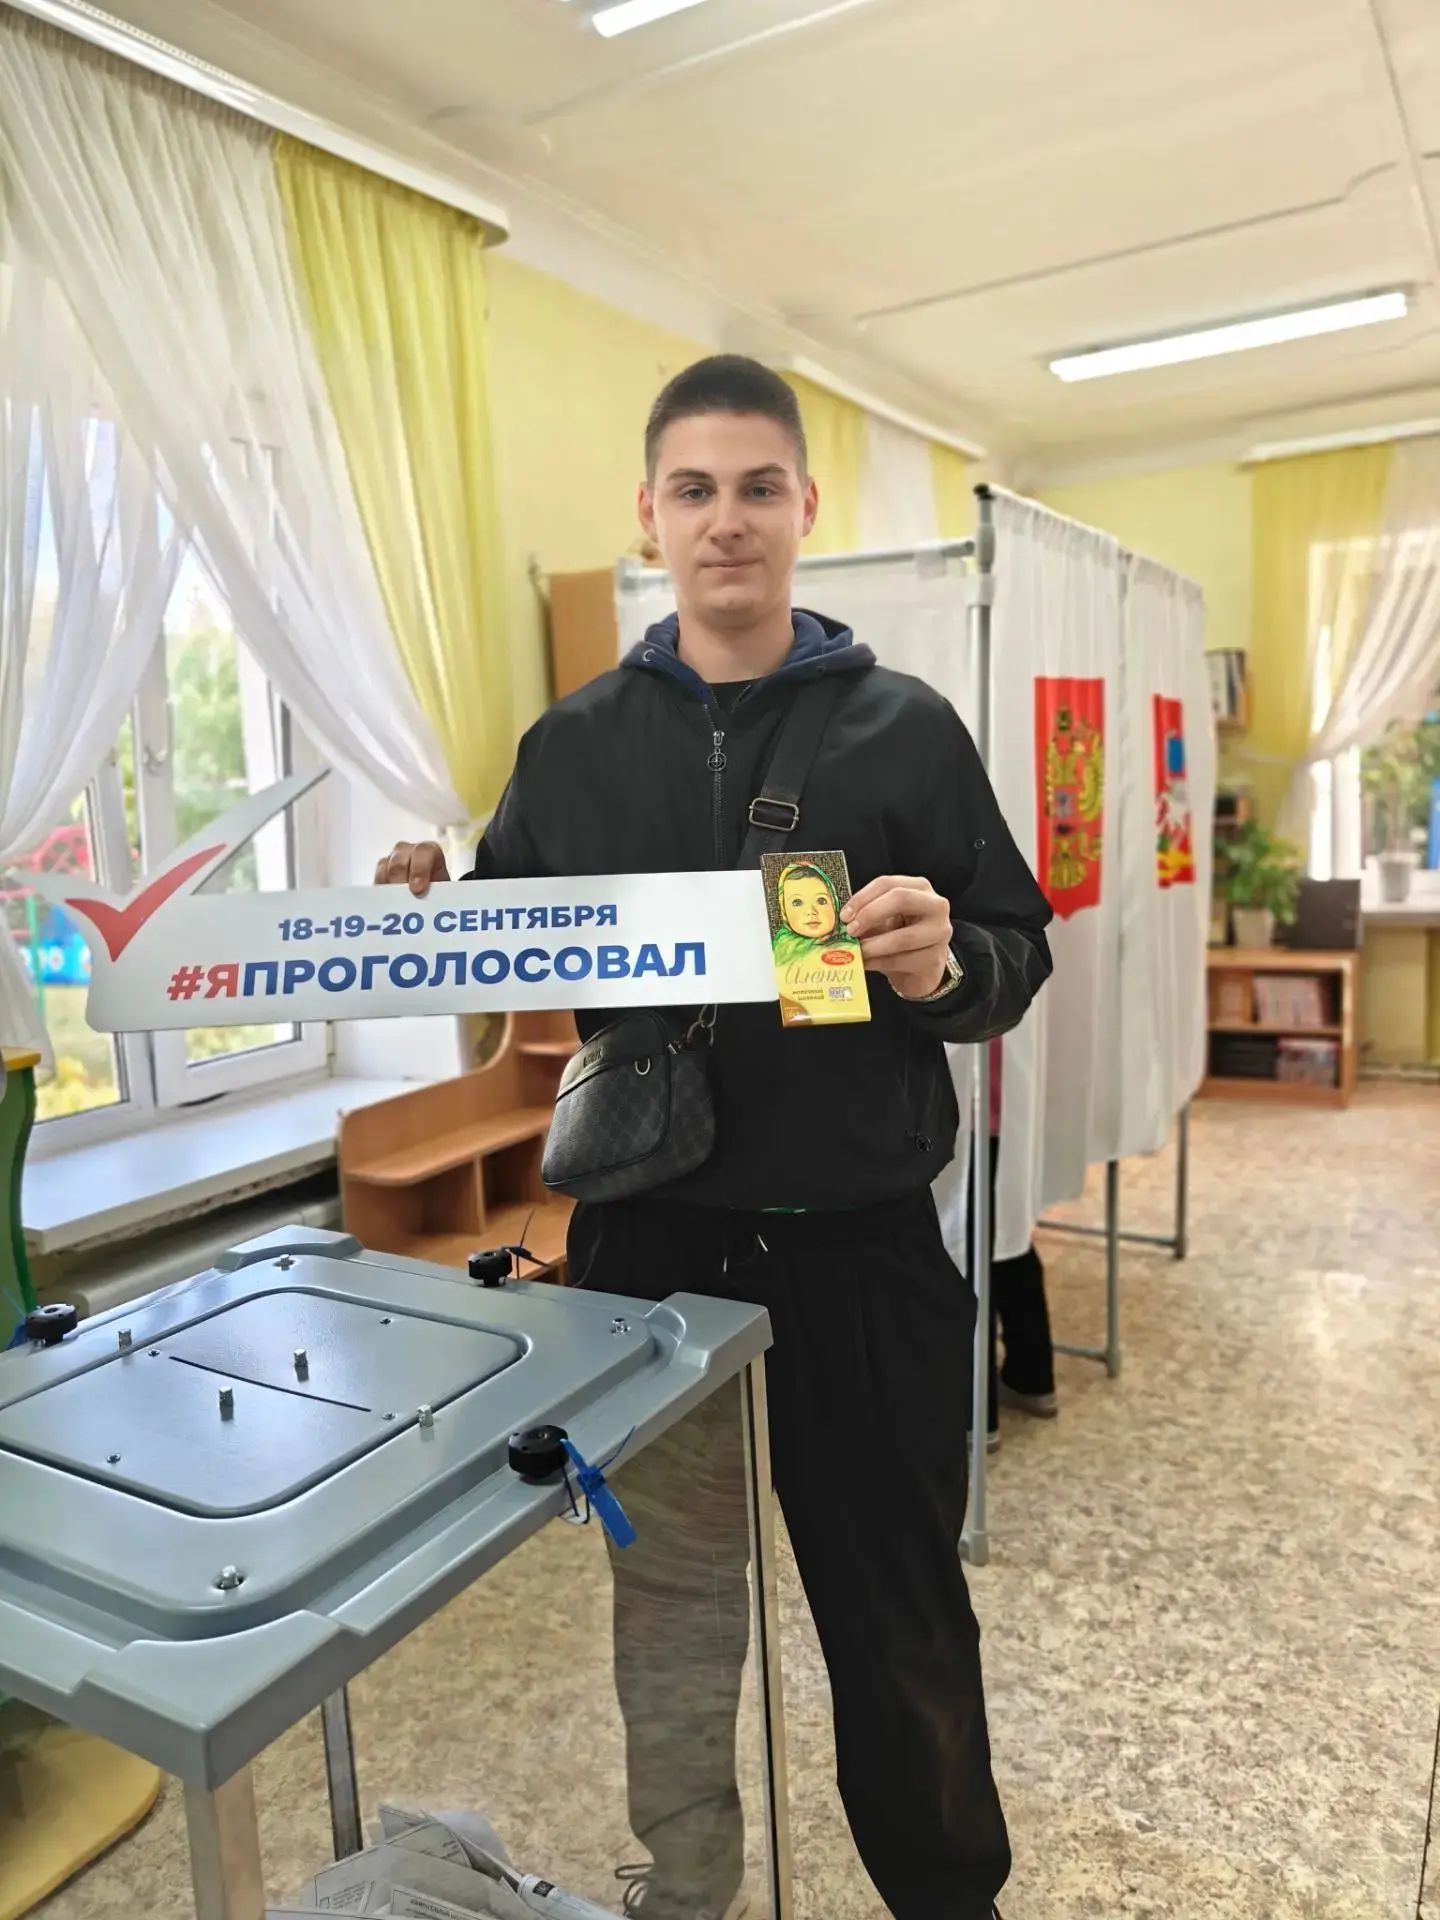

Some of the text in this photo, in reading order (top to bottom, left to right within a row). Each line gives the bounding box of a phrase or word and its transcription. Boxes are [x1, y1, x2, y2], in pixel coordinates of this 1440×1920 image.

[278, 904, 617, 940] 18-19-20 СЕНТЯБРЯ
[167, 942, 706, 1000] #ЯПРОГОЛОСОВАЛ
